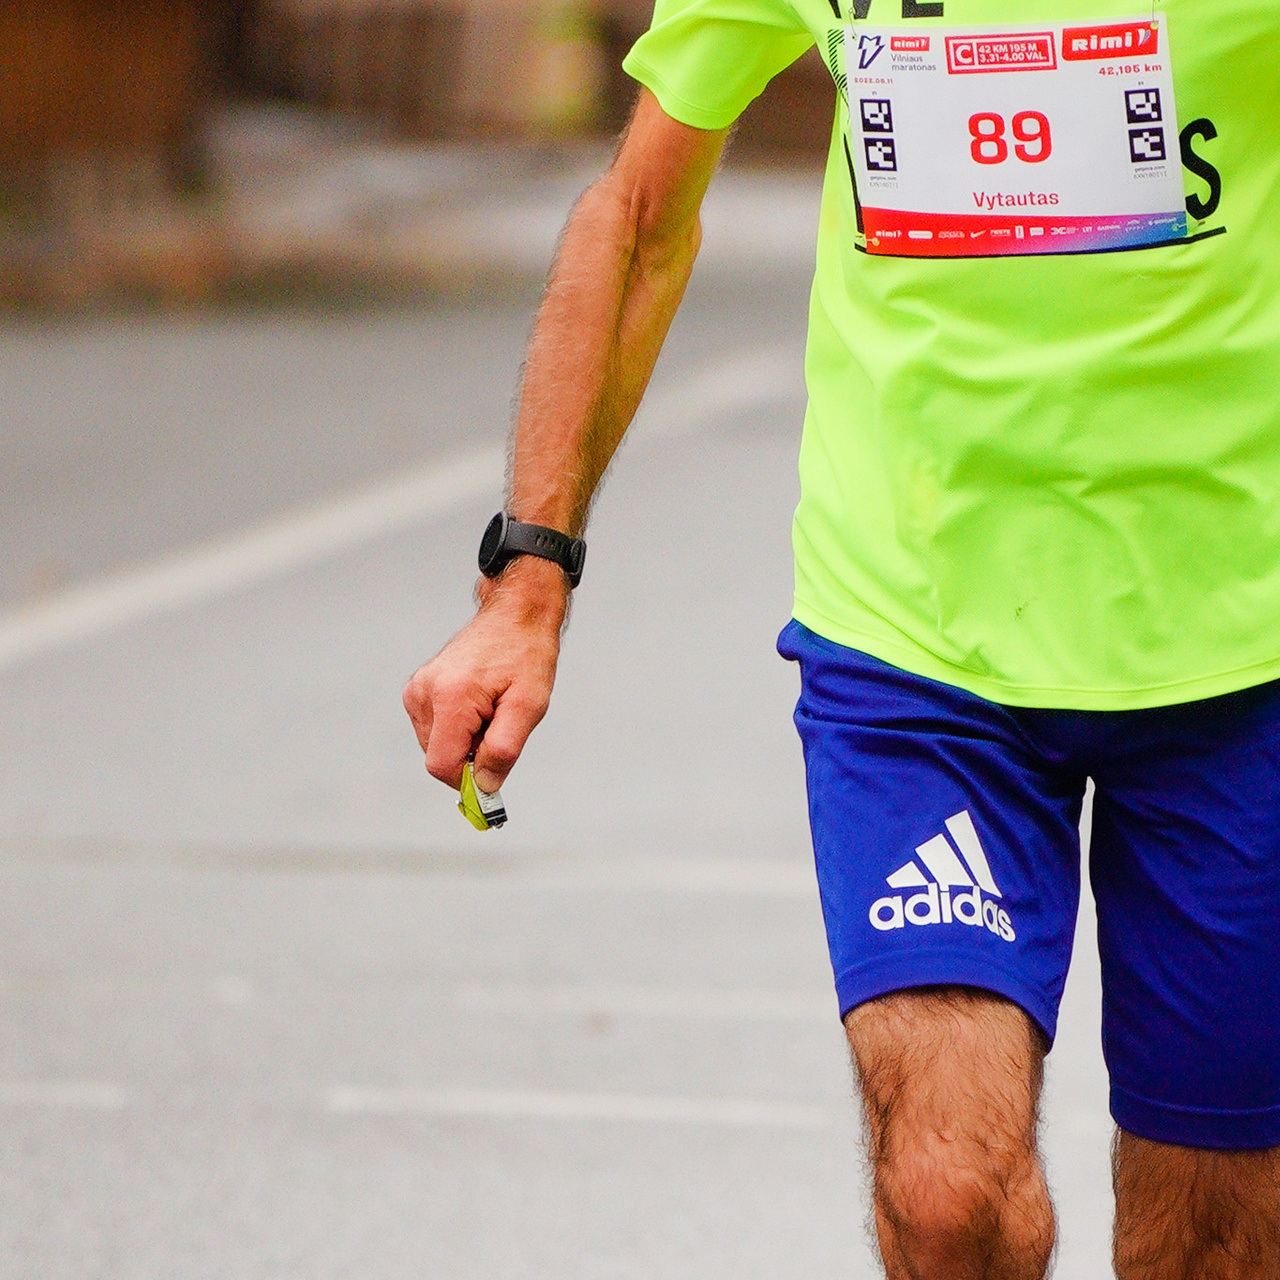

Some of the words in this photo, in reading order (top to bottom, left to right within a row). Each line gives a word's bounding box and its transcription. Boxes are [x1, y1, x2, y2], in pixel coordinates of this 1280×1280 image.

[979, 45, 991, 54] 42
[993, 44, 1008, 53] KM
[1010, 43, 1026, 52] 195
[1028, 43, 1037, 51] M
[1072, 31, 1133, 52] Rimi
[890, 54, 923, 62] Vilniaus
[956, 44, 973, 64] C
[979, 52, 1024, 63] 3.31-4.00
[1026, 51, 1047, 60] VAL.
[1099, 64, 1140, 76] 42,195
[1144, 63, 1162, 72] km
[968, 110, 1052, 165] 89
[973, 190, 1059, 211] Vytautas
[869, 882, 1016, 942] adidas
